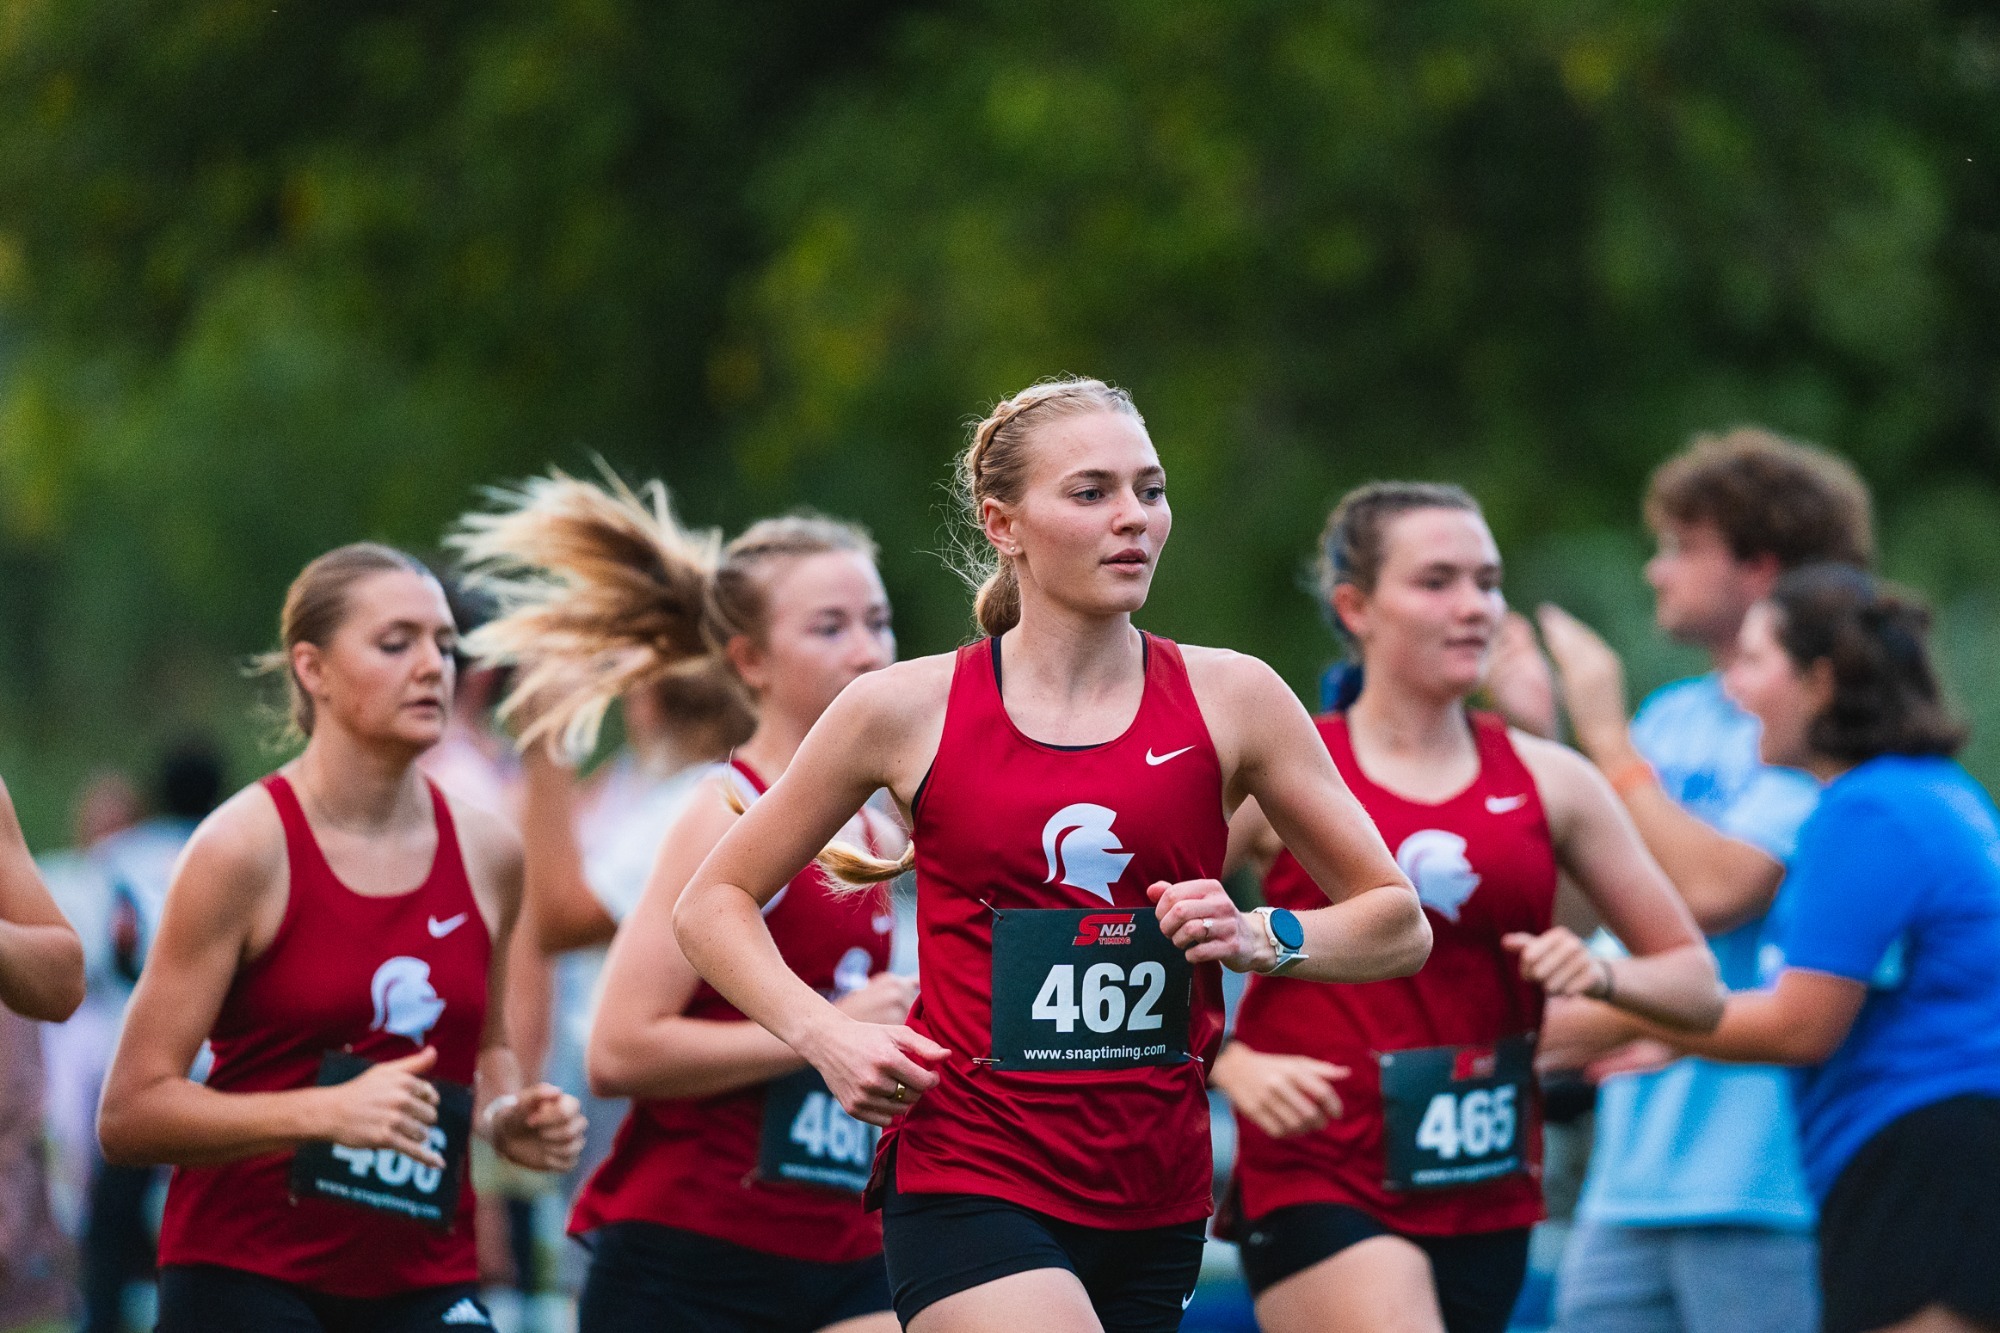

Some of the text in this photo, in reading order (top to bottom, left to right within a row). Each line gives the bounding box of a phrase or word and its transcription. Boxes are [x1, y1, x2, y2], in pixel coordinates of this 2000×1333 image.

[1072, 913, 1137, 946] SNAP
[1099, 937, 1131, 946] TIMING
[1031, 960, 1167, 1034] 462
[1023, 1044, 1166, 1062] www.snaptiming.com
[1415, 1083, 1518, 1161] 465
